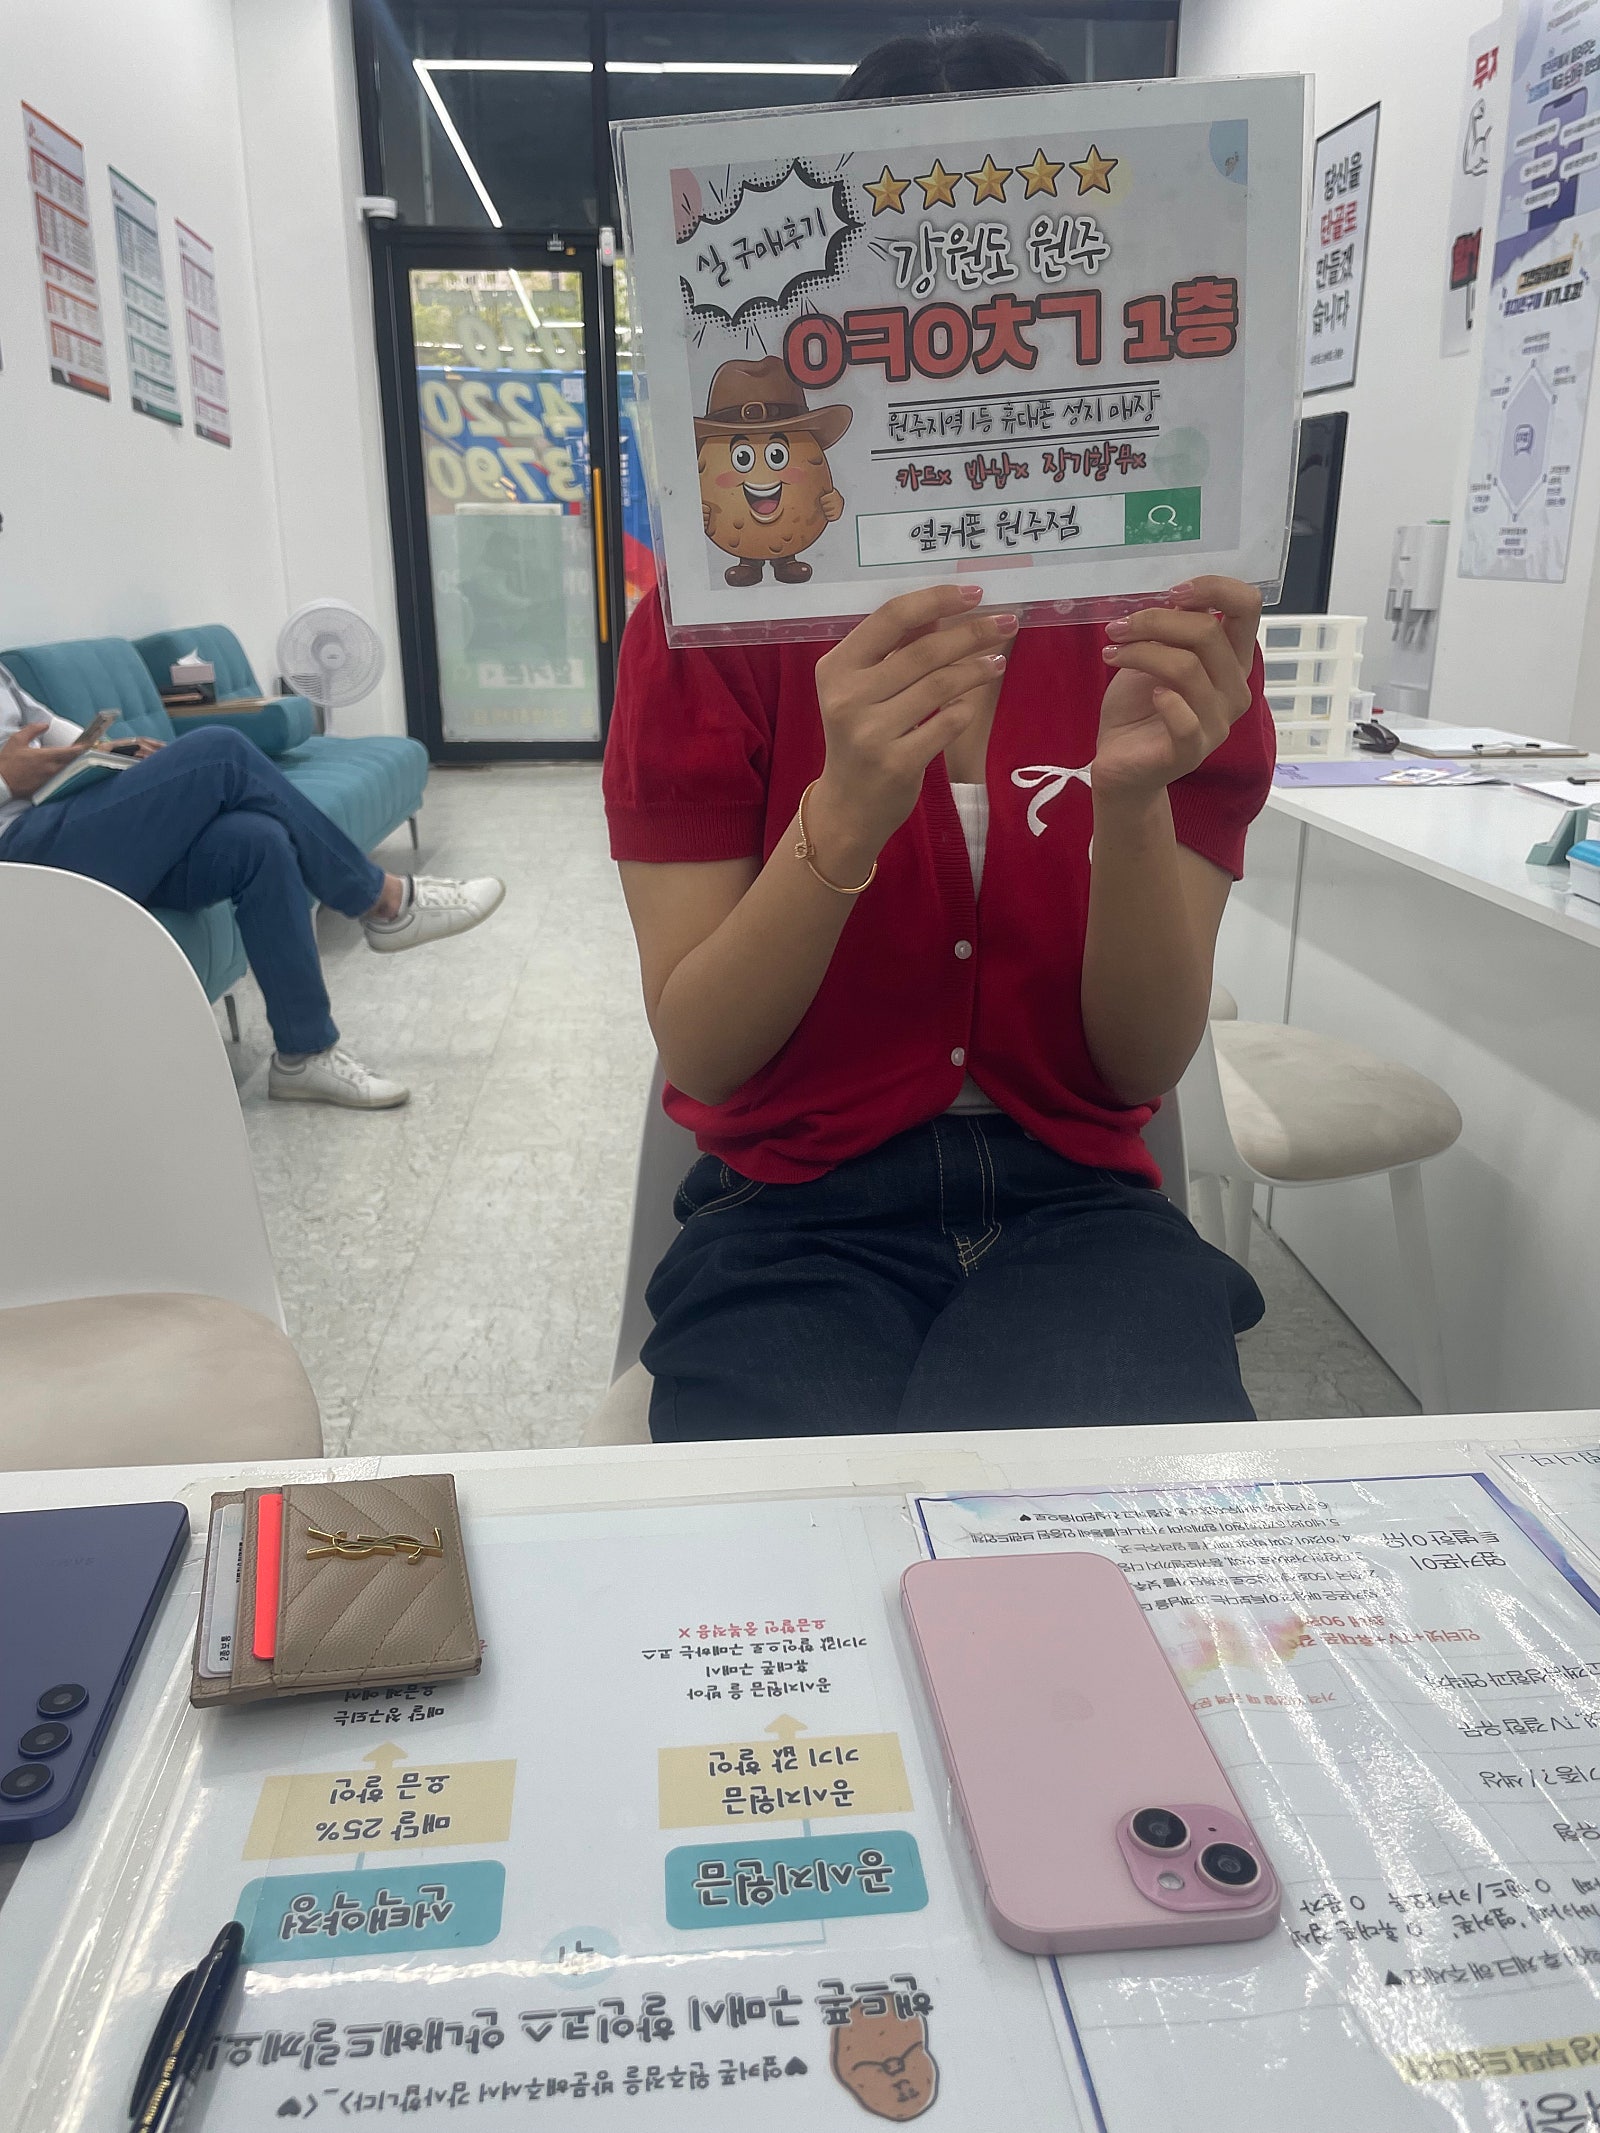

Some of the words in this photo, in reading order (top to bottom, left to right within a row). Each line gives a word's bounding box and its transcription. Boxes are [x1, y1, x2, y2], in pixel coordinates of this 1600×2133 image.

[1323, 151, 1363, 201] 당신을
[1320, 200, 1358, 246] 단골로
[696, 244, 731, 288] 실
[732, 208, 827, 271] 구매후기
[890, 222, 1014, 296] 강원도
[1030, 219, 1108, 280] 원주
[1314, 243, 1355, 290] 만들겠
[1311, 289, 1350, 336] 습니다
[782, 288, 1103, 390] ㅇㅋㅇㅊㄱ
[1123, 276, 1239, 364] 1층
[888, 409, 964, 442] 원주지역
[970, 405, 993, 433] 1등
[1000, 400, 1055, 434] 휴대폰
[1062, 398, 1103, 425] 성지
[1109, 389, 1161, 422] 매장
[910, 516, 986, 552] 옆커폰
[996, 505, 1081, 547] 원주점
[1037, 1529, 1076, 1541] 인증된
[1381, 1532, 1428, 1549] 이유
[1409, 1551, 1506, 1571] 옆커폰이
[696, 1622, 759, 1640] 중복적용
[764, 1618, 827, 1635] 요금할인
[640, 1648, 673, 1661] 코스
[678, 1642, 744, 1659] 구매하는
[749, 1638, 815, 1655] 할인으로
[820, 1636, 868, 1652] 기기값
[705, 1662, 755, 1678] 구매시
[760, 1659, 809, 1676] 휴대폰
[686, 1684, 722, 1702] 받아
[728, 1682, 744, 1700] 을
[750, 1677, 832, 1698] 공시지원금
[333, 1706, 403, 1727] 청구되는
[407, 1704, 446, 1722] 매달
[708, 1748, 762, 1777] 할인
[771, 1745, 799, 1774] 값
[808, 1745, 860, 1767] 기기
[329, 1774, 384, 1805] 할인
[396, 1771, 451, 1800] 요금
[1478, 1771, 1524, 1789] 색상
[721, 1779, 856, 1816] 공시지원금
[315, 1816, 385, 1842] 25%
[390, 1810, 451, 1842] 매달
[692, 1850, 895, 1907] 공시지원금
[280, 1884, 455, 1941] 선택약정
[690, 1986, 804, 2031] 구매시
[817, 1975, 934, 2026] 핸드폰
[520, 1995, 676, 2044] 할인코스
[622, 2060, 711, 2096] 원주점을
[719, 2055, 783, 2086] 옆커폰
[478, 2070, 615, 2104] 방문해주셔서
